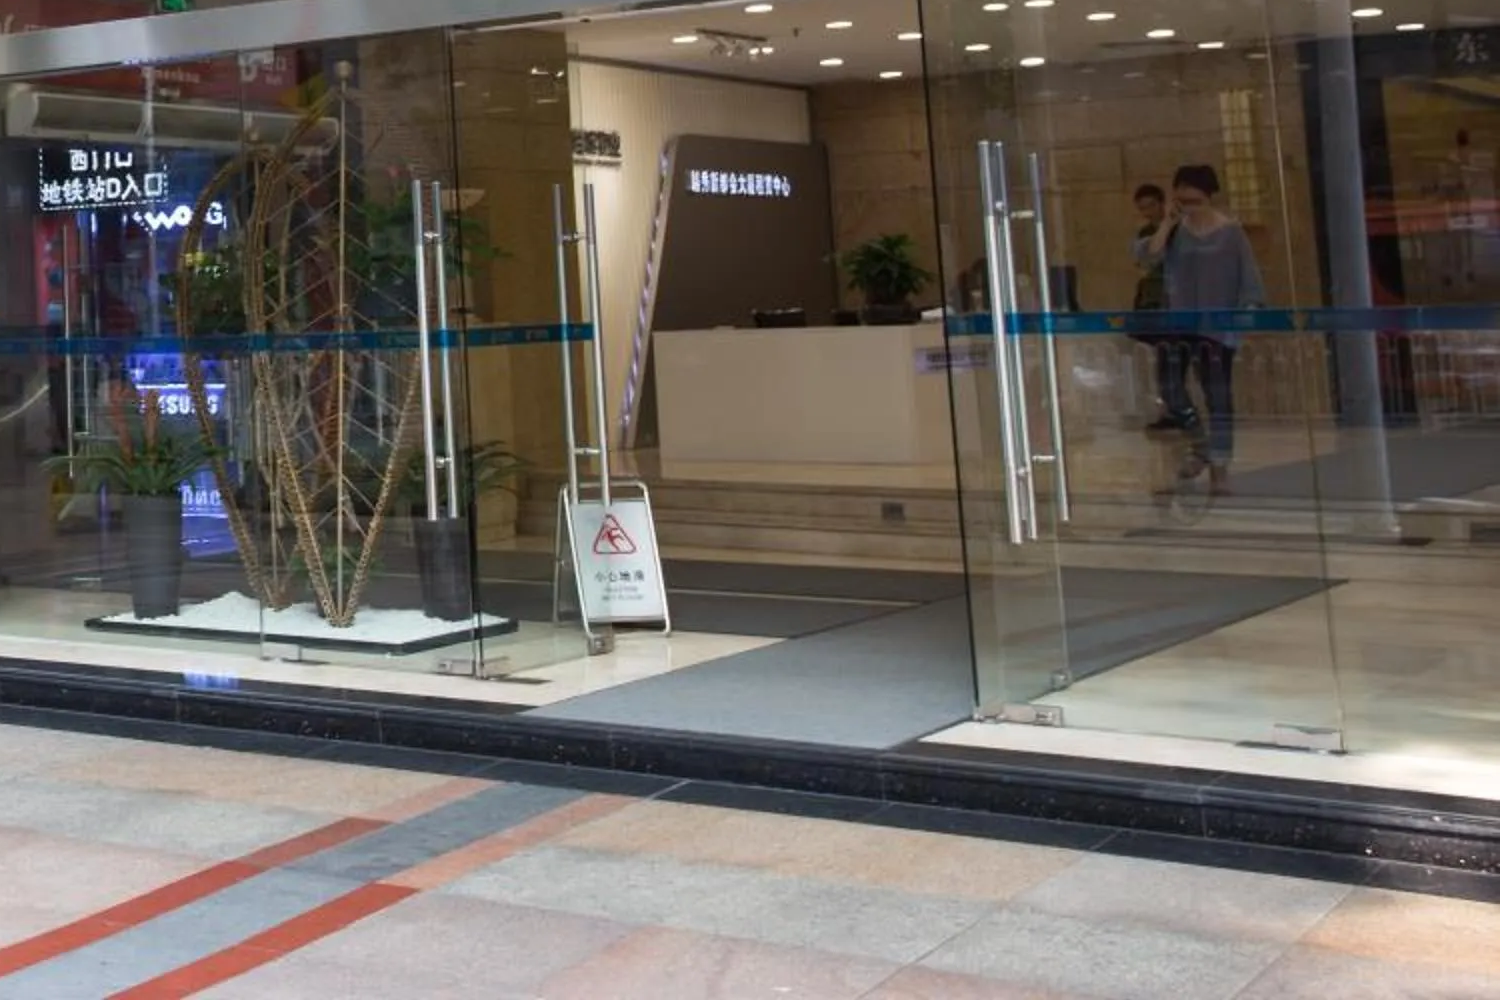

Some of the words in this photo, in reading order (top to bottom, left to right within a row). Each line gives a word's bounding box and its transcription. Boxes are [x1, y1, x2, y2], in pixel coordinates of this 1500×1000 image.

[41, 173, 164, 203] 地铁站D入口
